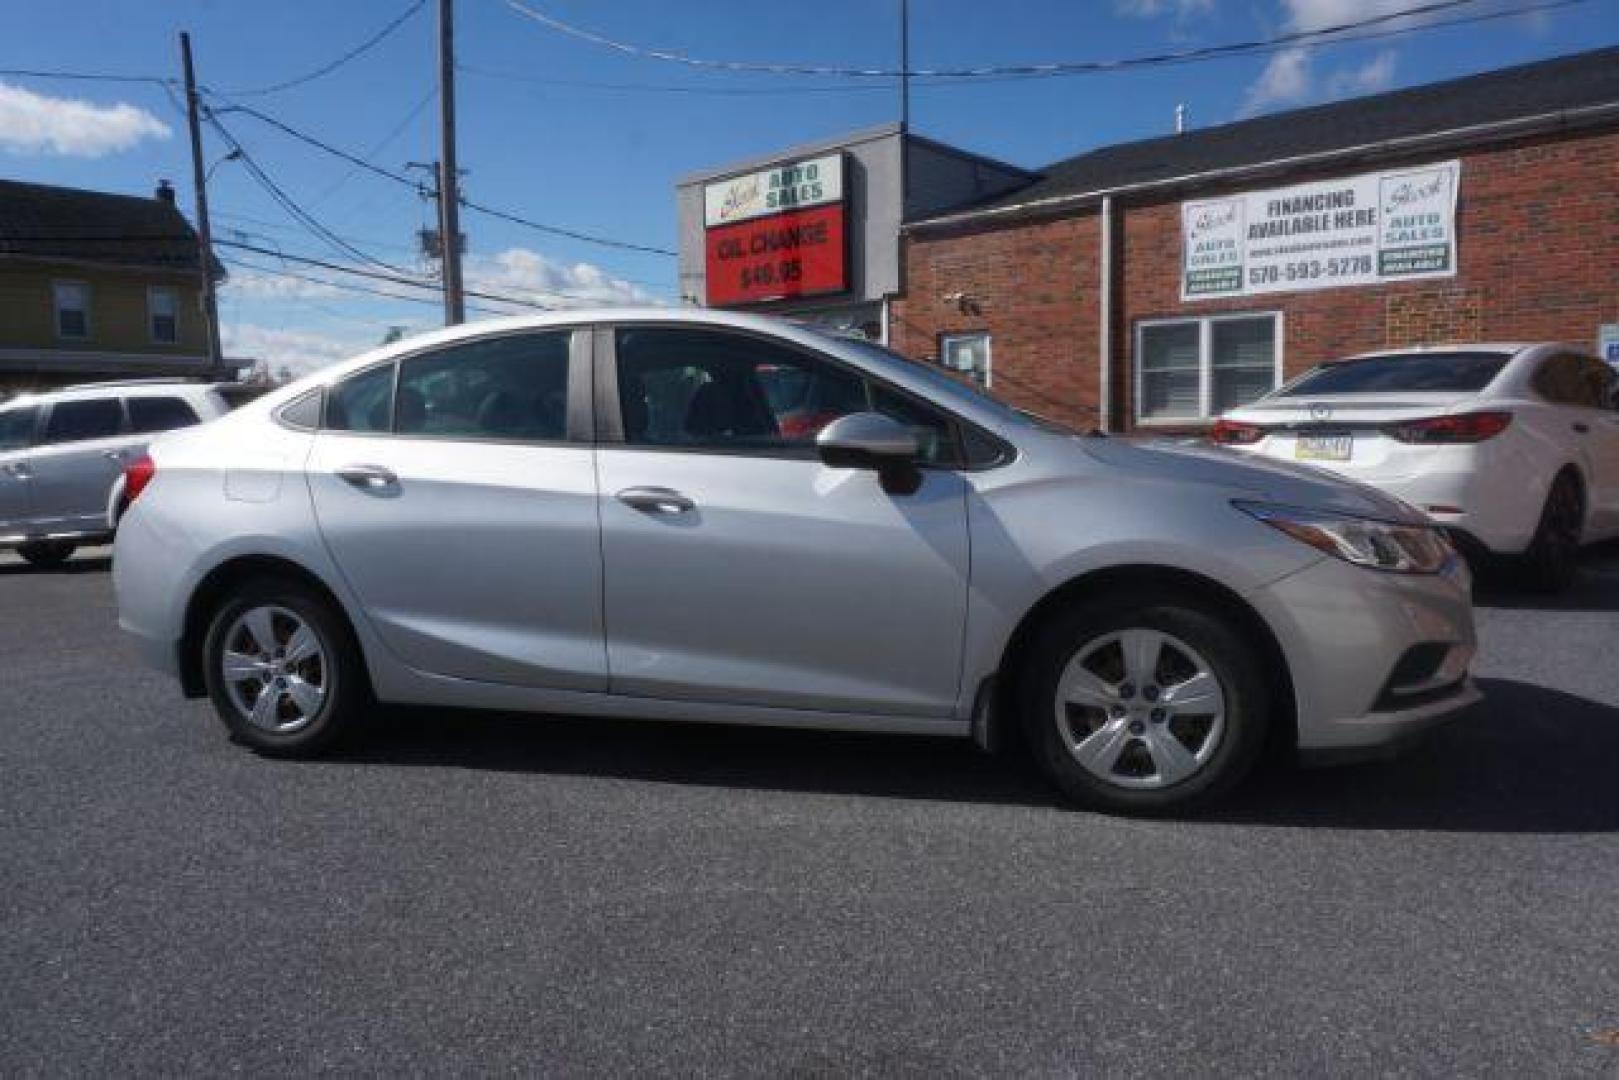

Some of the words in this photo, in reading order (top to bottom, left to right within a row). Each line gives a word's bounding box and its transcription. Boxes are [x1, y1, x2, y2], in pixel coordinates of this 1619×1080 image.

[769, 164, 818, 187] AUTO
[766, 182, 822, 208] SALES
[1267, 189, 1354, 217] FINANCING
[1247, 213, 1328, 240] AVAILABLE
[1335, 207, 1377, 229] HERE
[1390, 212, 1440, 228] AUTO
[717, 236, 748, 260] OIL
[750, 220, 828, 254] CHANGE
